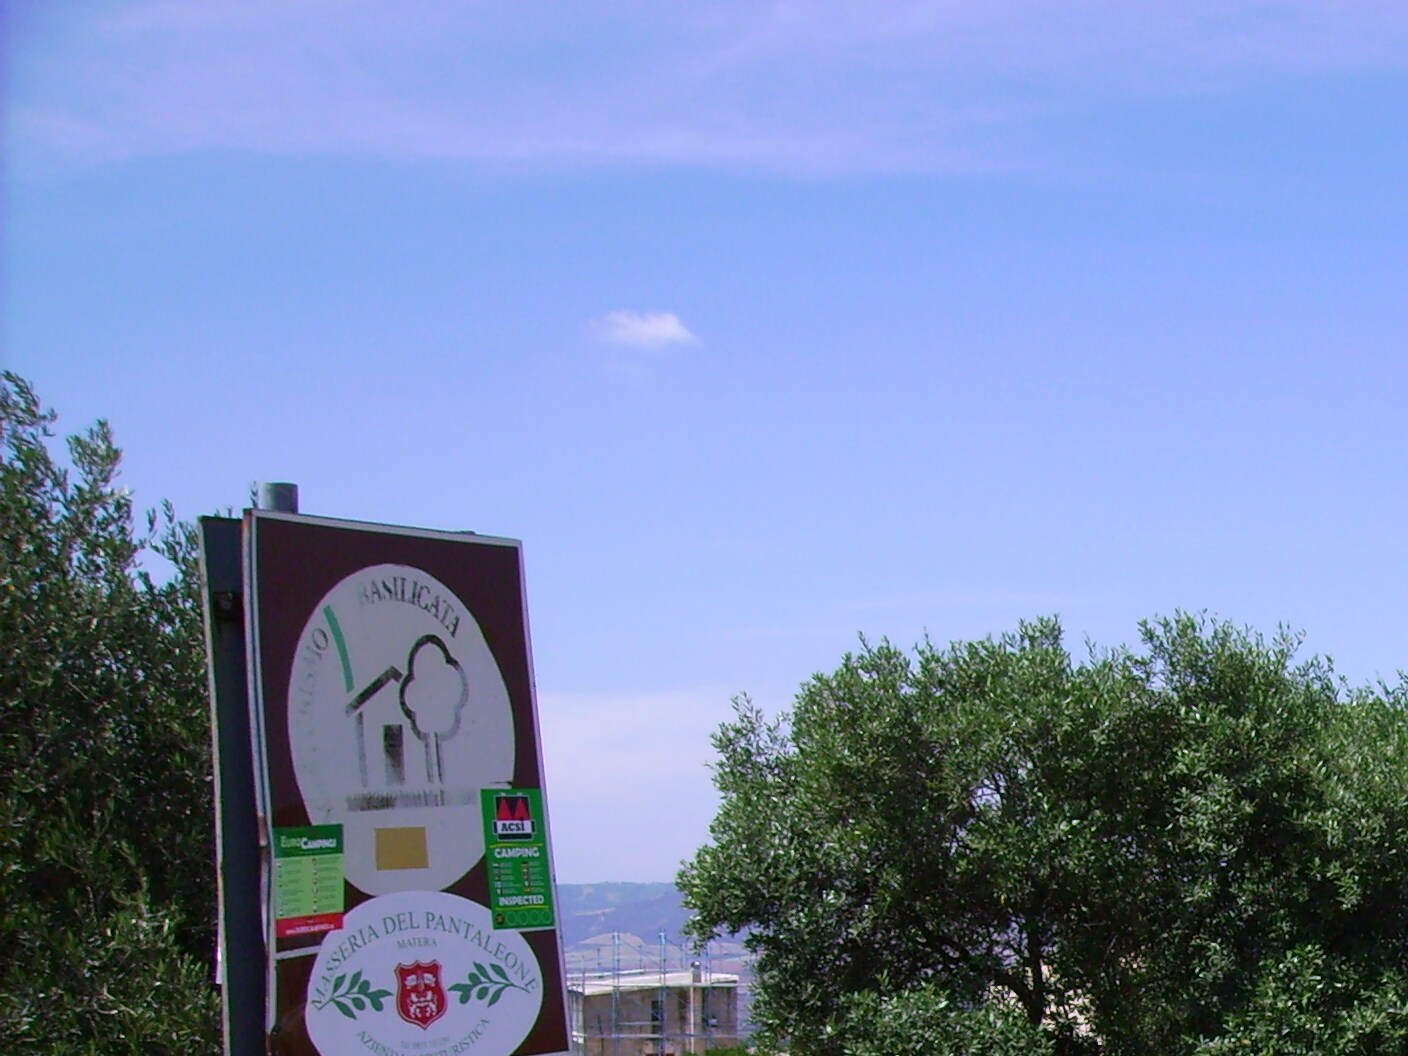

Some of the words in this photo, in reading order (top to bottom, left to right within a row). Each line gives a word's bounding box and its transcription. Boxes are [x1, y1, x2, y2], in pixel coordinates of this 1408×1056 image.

[494, 847, 540, 858] CAMPING
[498, 895, 544, 906] INSPECTED
[397, 936, 438, 949] MATERA
[311, 924, 380, 1005] MASSERIA
[382, 911, 420, 935] DEL
[425, 911, 538, 992] PANTALEONE
